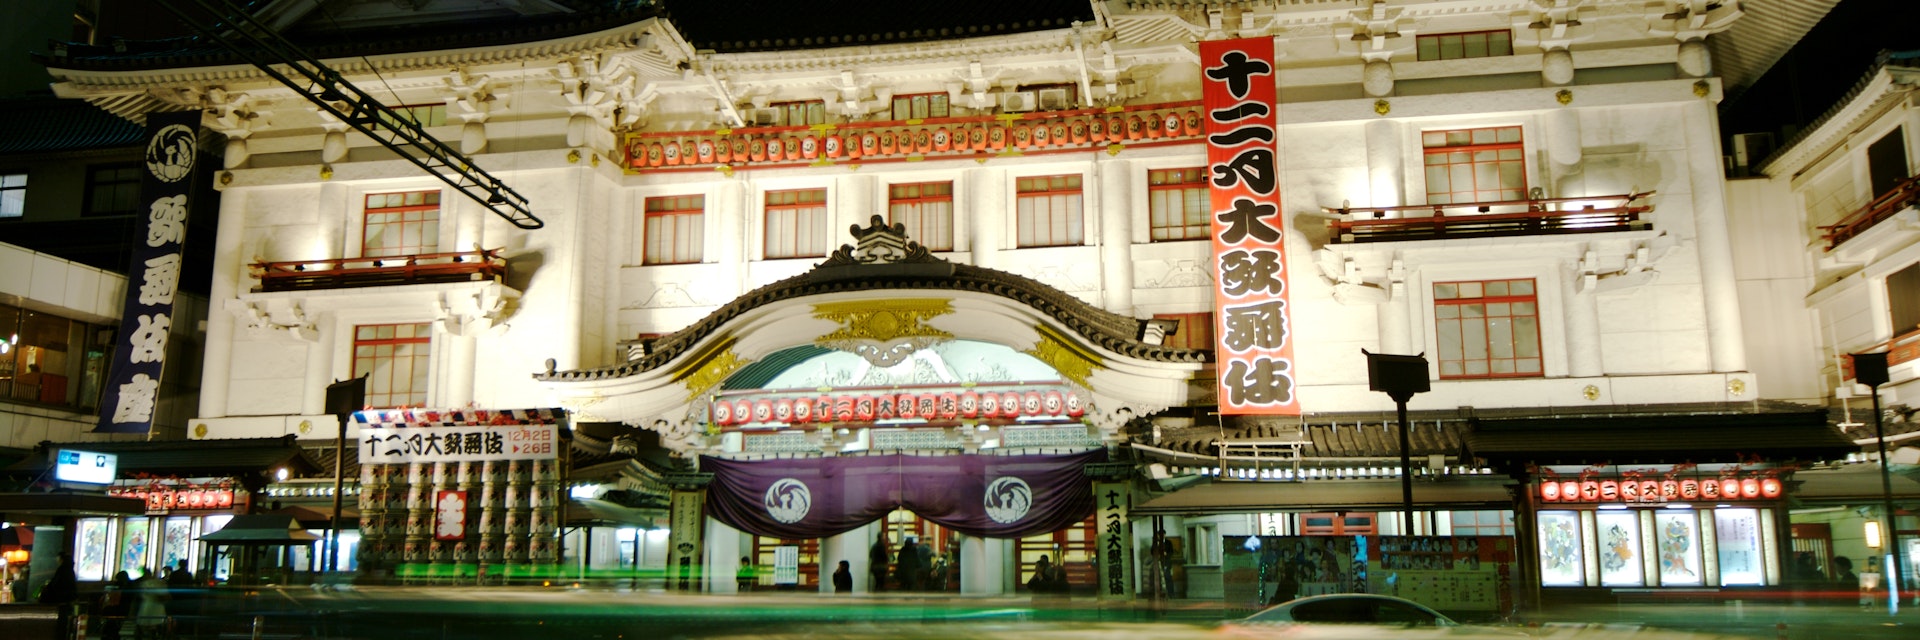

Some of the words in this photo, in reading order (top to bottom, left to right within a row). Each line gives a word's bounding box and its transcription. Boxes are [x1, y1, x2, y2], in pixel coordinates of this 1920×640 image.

[1206, 51, 1292, 405] 十二月大歌舞伎
[112, 193, 187, 424] 歌舞伎座
[364, 431, 503, 457] 十二月大歌舞伎
[508, 429, 551, 442] 12月2日
[523, 442, 551, 454] 26日
